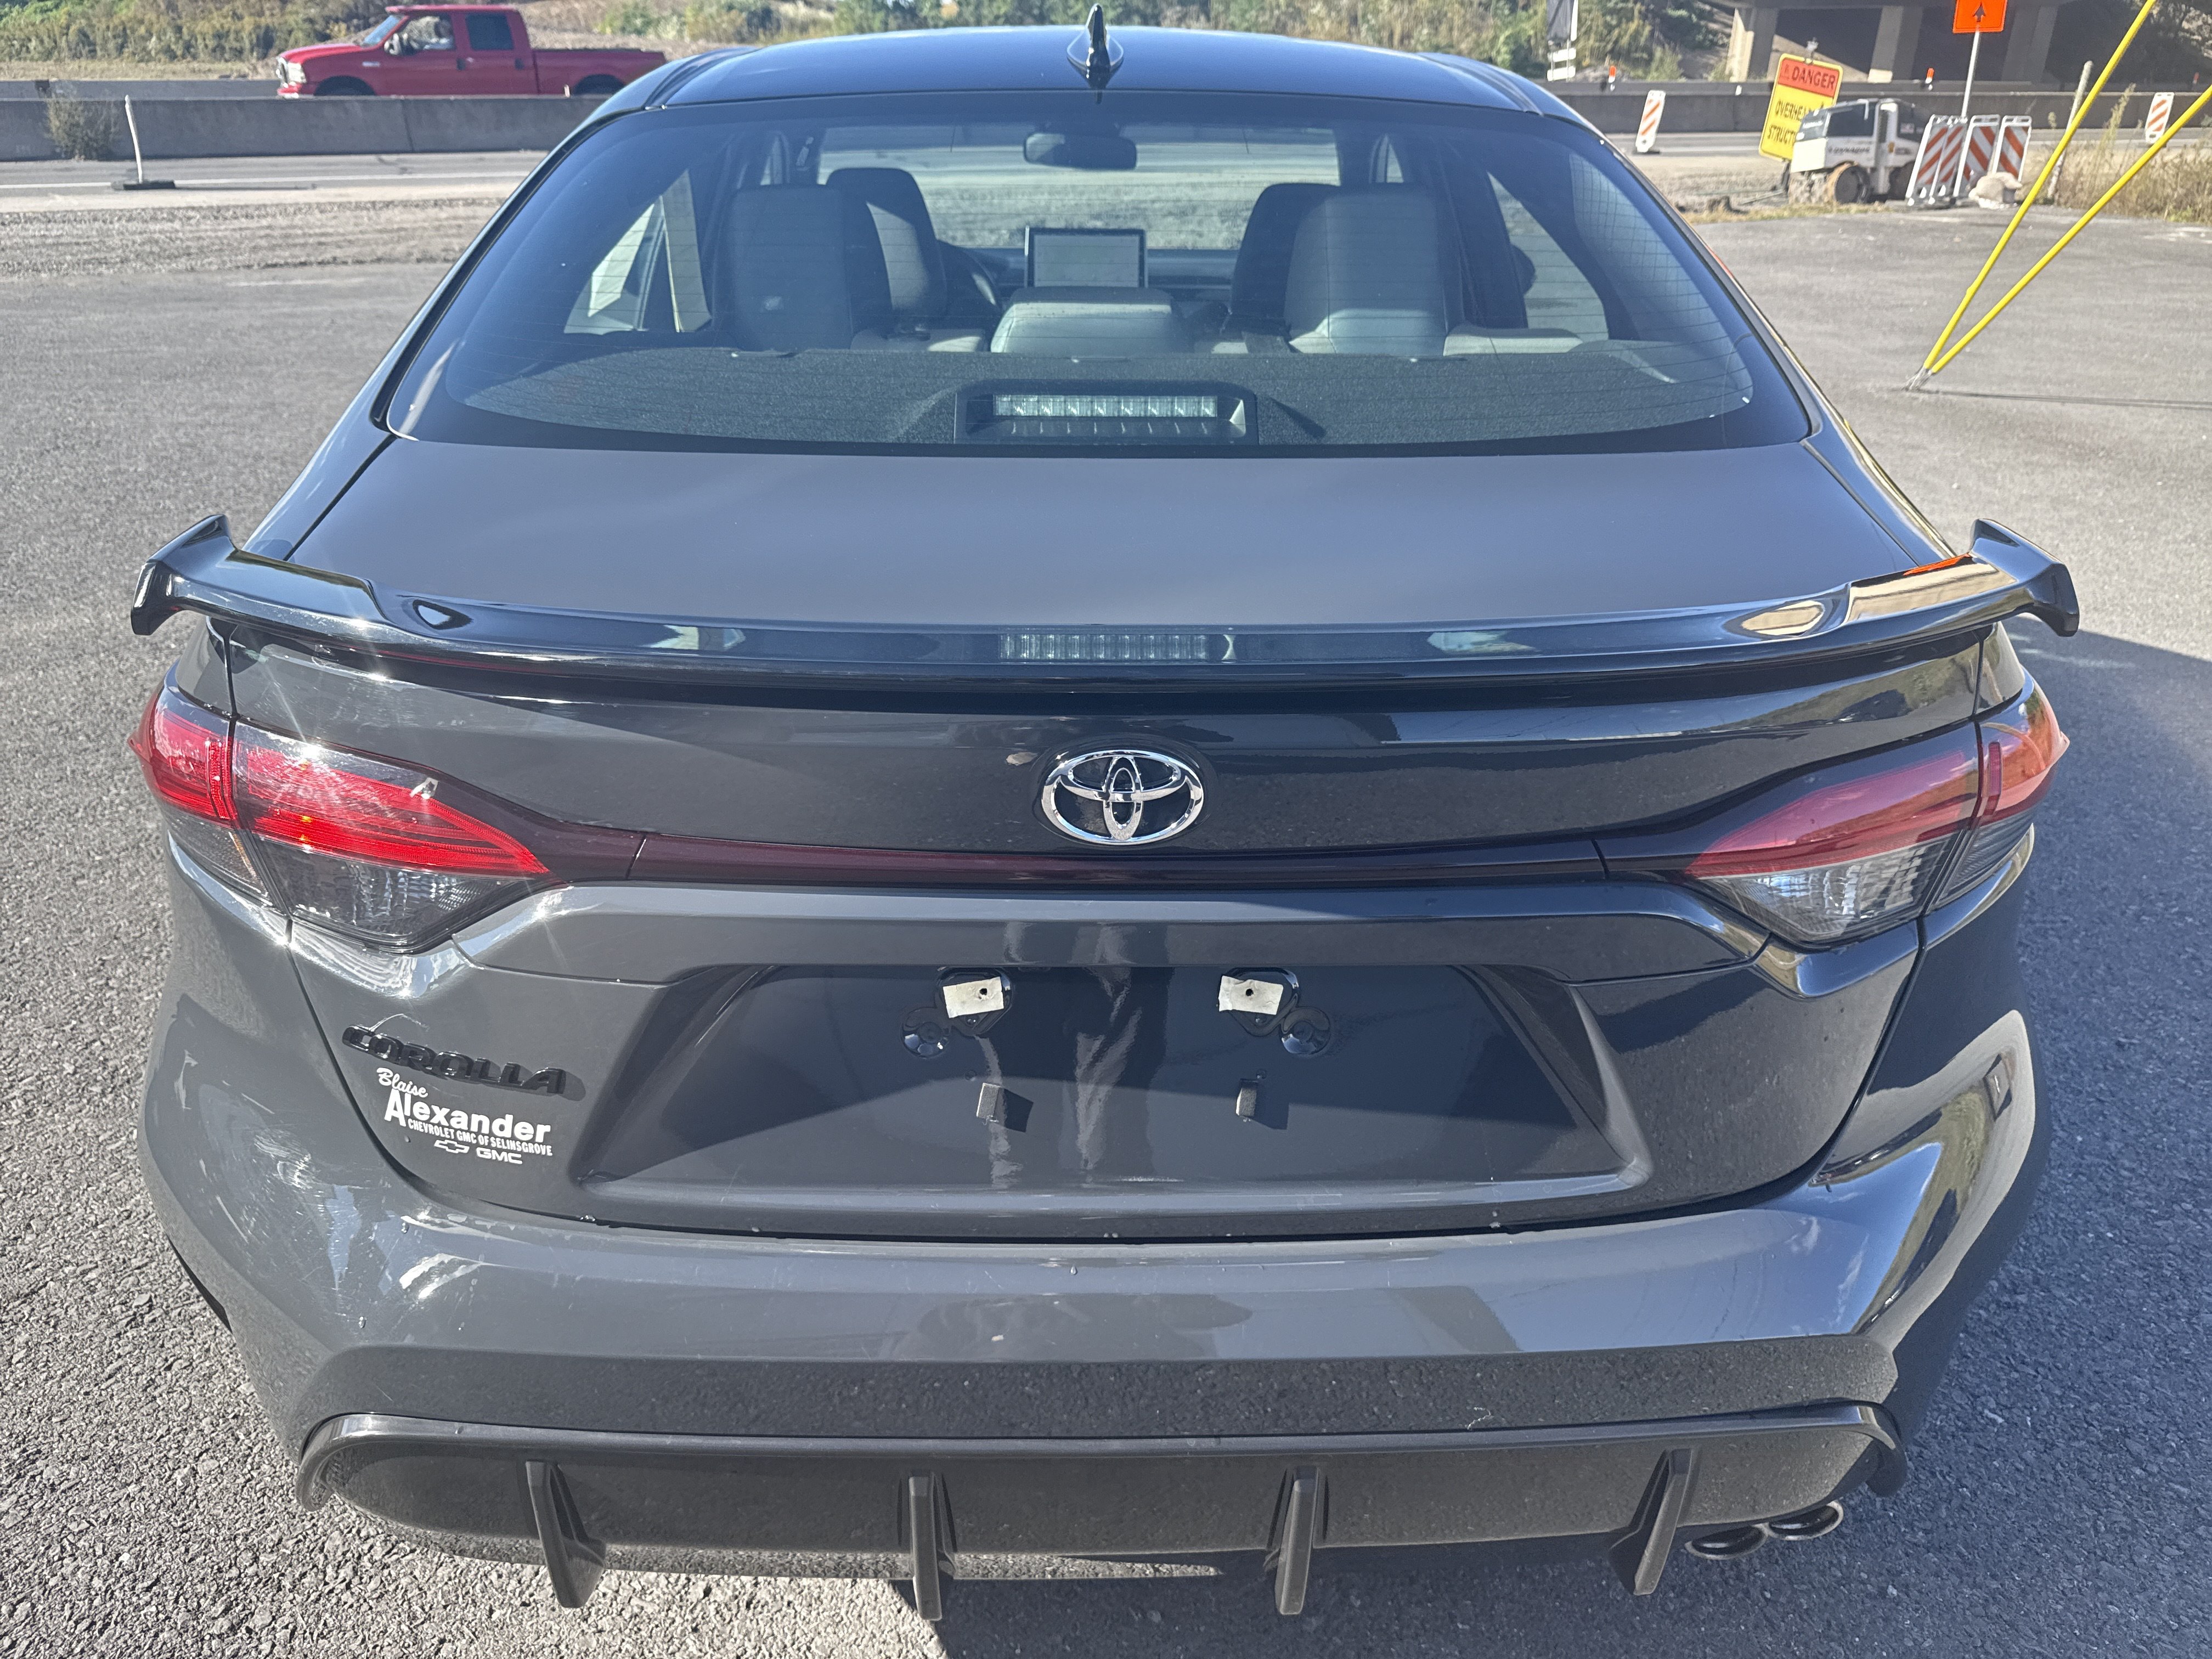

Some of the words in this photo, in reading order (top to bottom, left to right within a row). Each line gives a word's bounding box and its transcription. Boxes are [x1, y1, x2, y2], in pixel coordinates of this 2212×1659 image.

[1792, 66, 1836, 90] DANGER
[1775, 101, 1810, 121] OVERHEA
[342, 1025, 566, 1094] COROLLA
[376, 1067, 428, 1098] Blaise
[384, 1088, 551, 1143] Alexander
[408, 1118, 455, 1139] CHEVROLET
[456, 1129, 477, 1144] GMC
[478, 1136, 490, 1147] OF
[490, 1136, 553, 1156] SELINSGROVE
[476, 1147, 523, 1164] GMC
